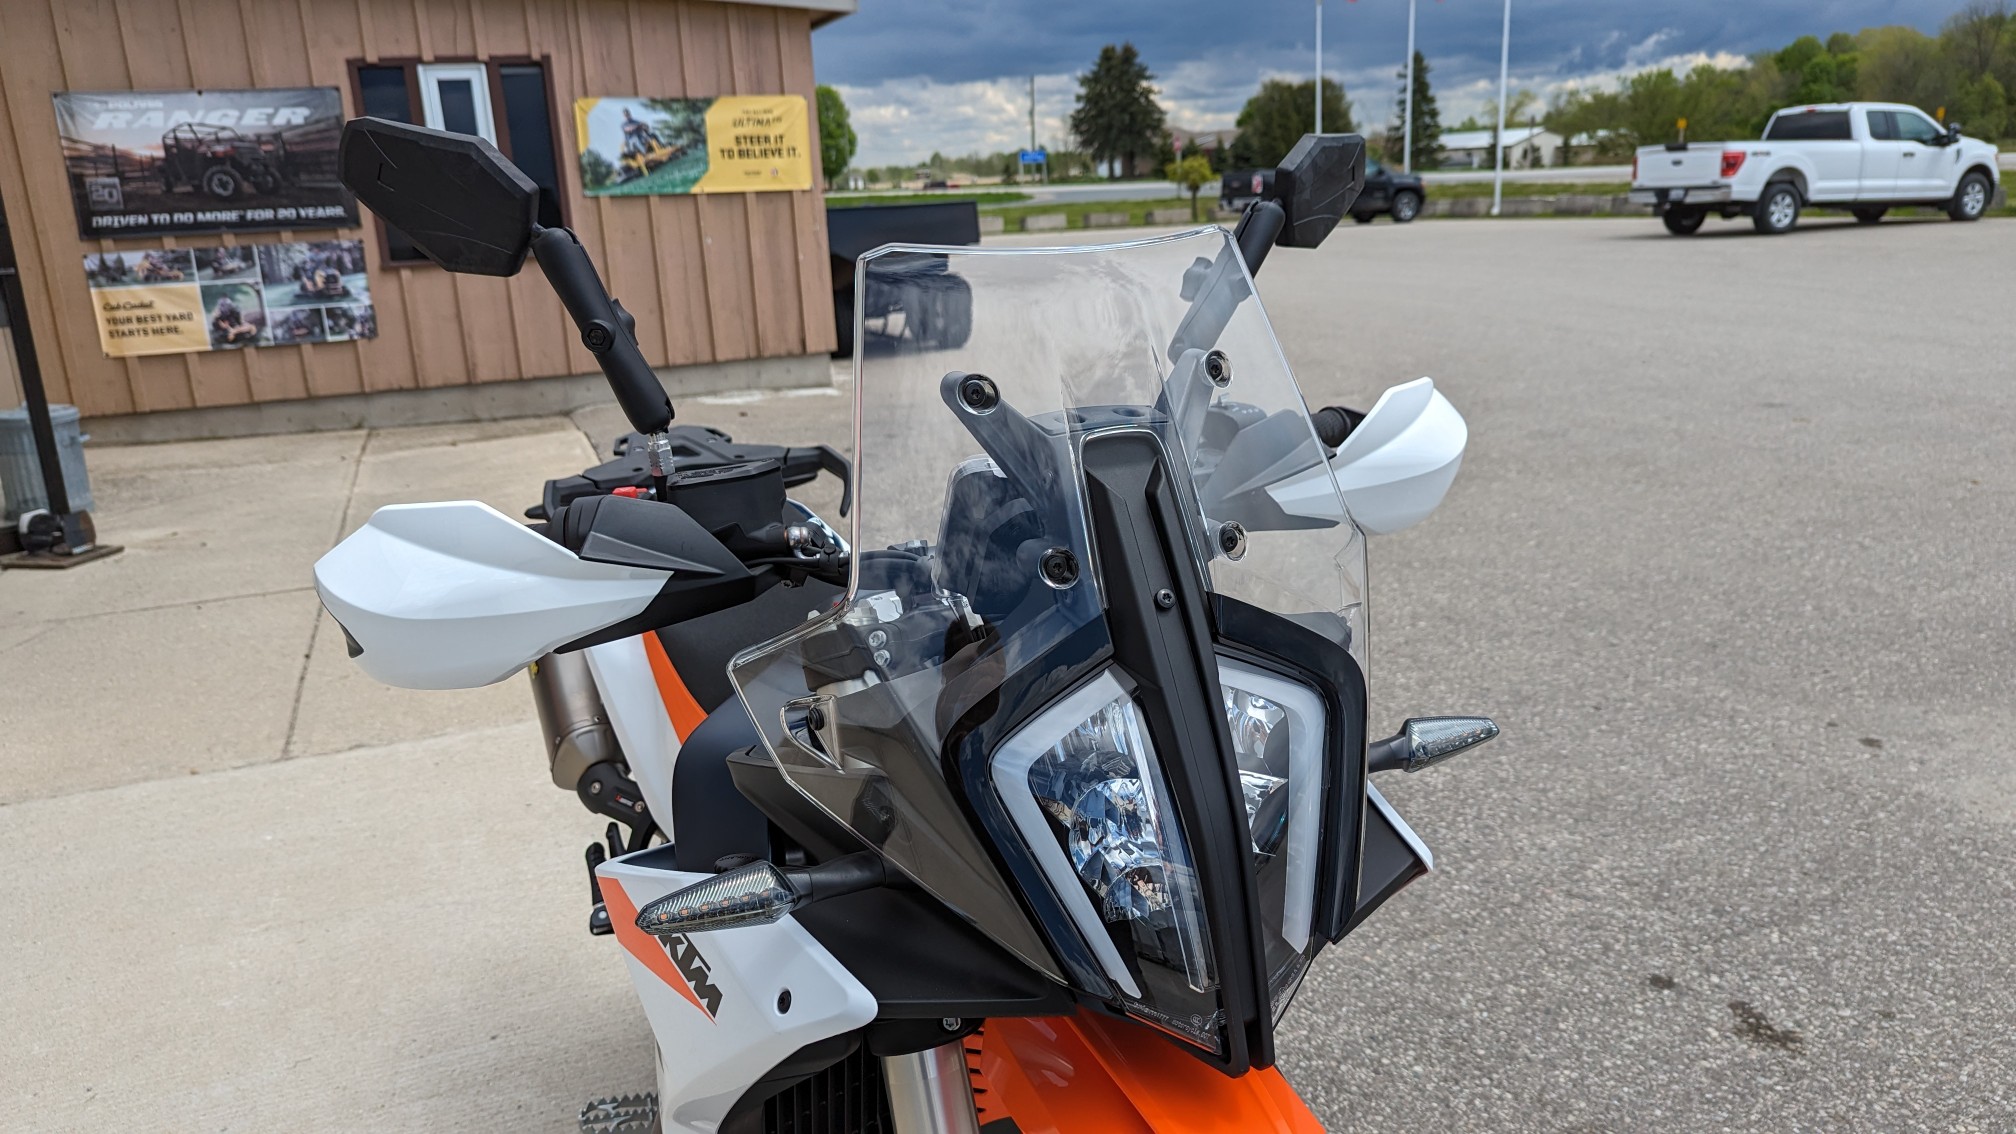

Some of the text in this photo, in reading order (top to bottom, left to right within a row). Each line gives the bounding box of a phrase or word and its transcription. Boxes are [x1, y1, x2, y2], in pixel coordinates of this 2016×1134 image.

[92, 106, 311, 130] RANGER
[735, 133, 784, 146] STEER IT
[720, 148, 735, 160] TO
[737, 147, 784, 159] BELIEVE
[92, 214, 148, 228] DRIVEN
[151, 212, 170, 225] TO
[173, 211, 194, 224] DO
[246, 208, 275, 222] FOR
[106, 311, 194, 327] YOUR BEST YARD
[108, 327, 149, 340] STARTS
[659, 934, 723, 1018] KTM
